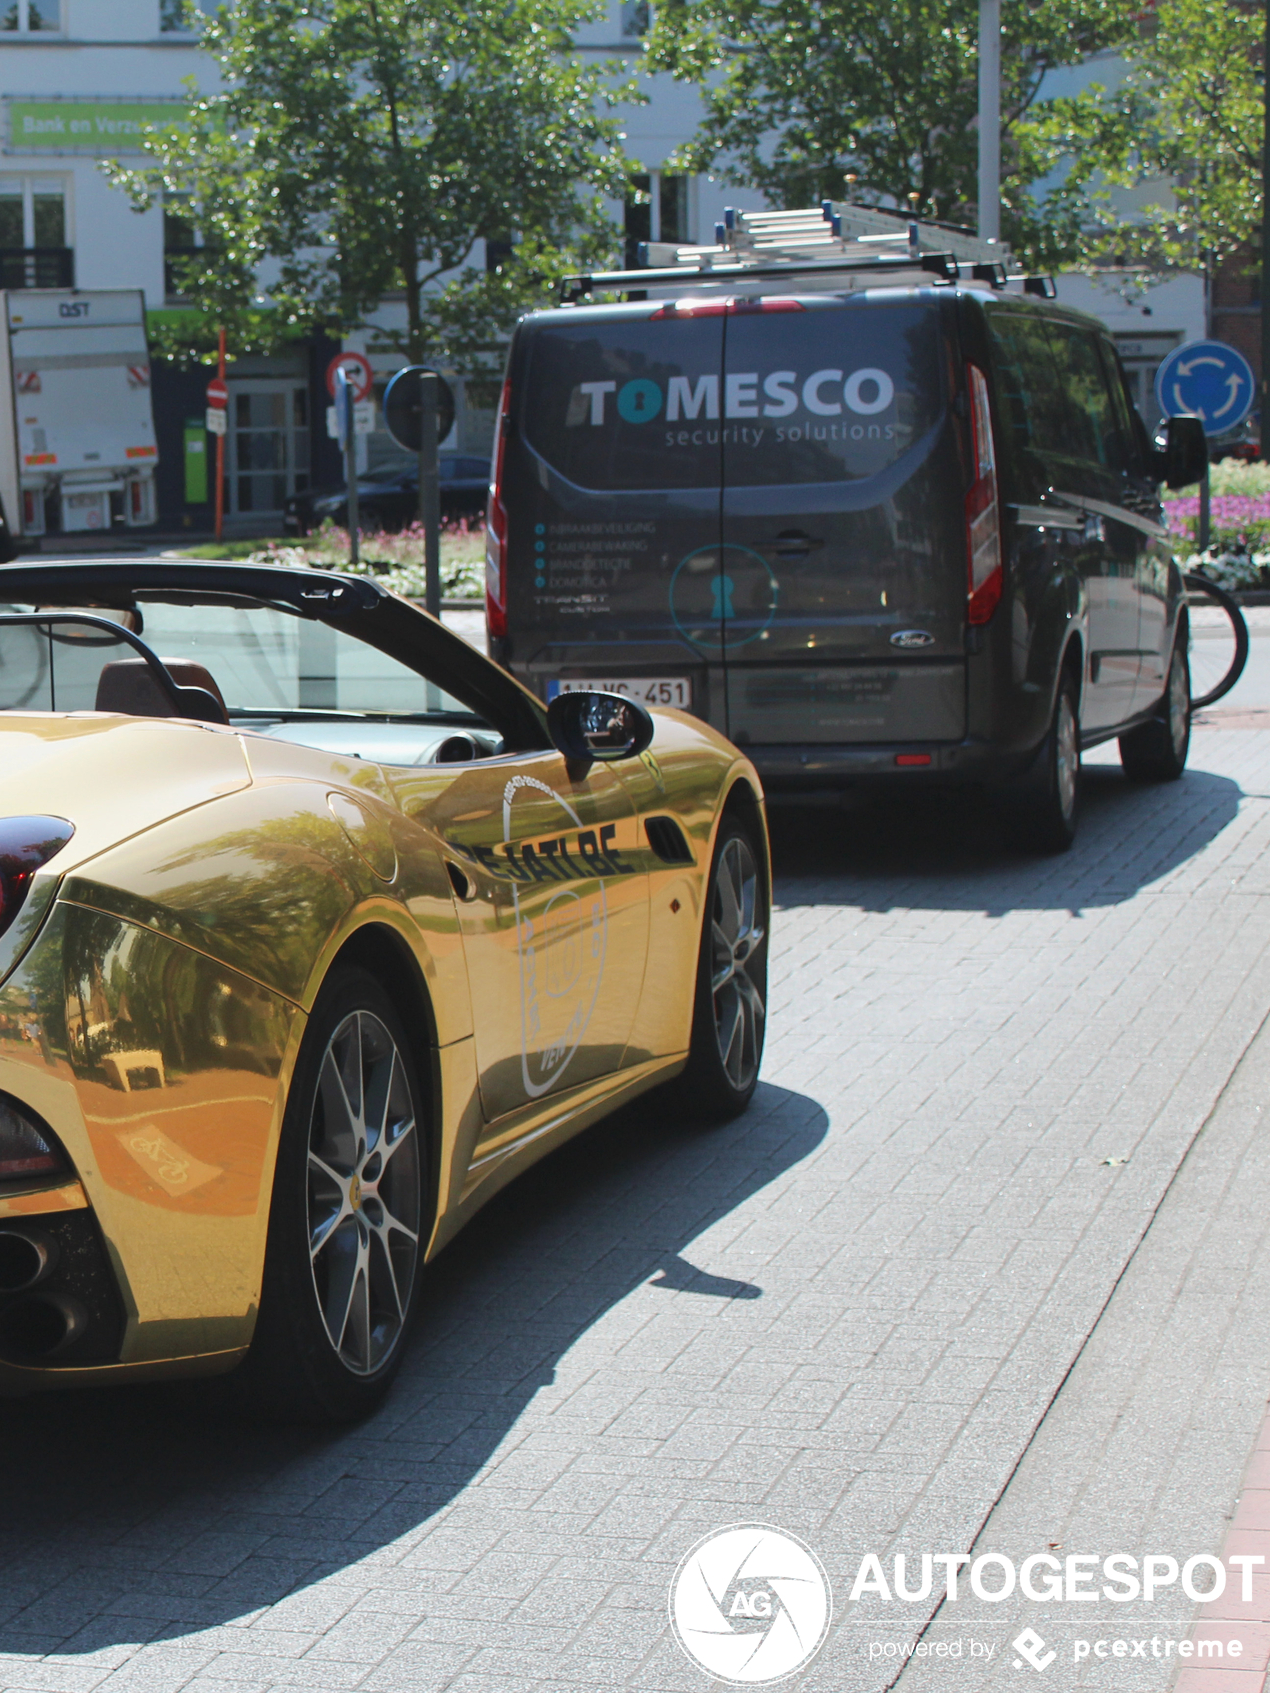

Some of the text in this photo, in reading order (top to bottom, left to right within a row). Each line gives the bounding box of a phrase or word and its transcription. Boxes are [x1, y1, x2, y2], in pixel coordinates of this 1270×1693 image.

[23, 115, 66, 134] Bank
[69, 119, 92, 134] en
[59, 302, 90, 318] DST
[580, 367, 894, 426] TOMESCO
[665, 420, 895, 447] security solutions
